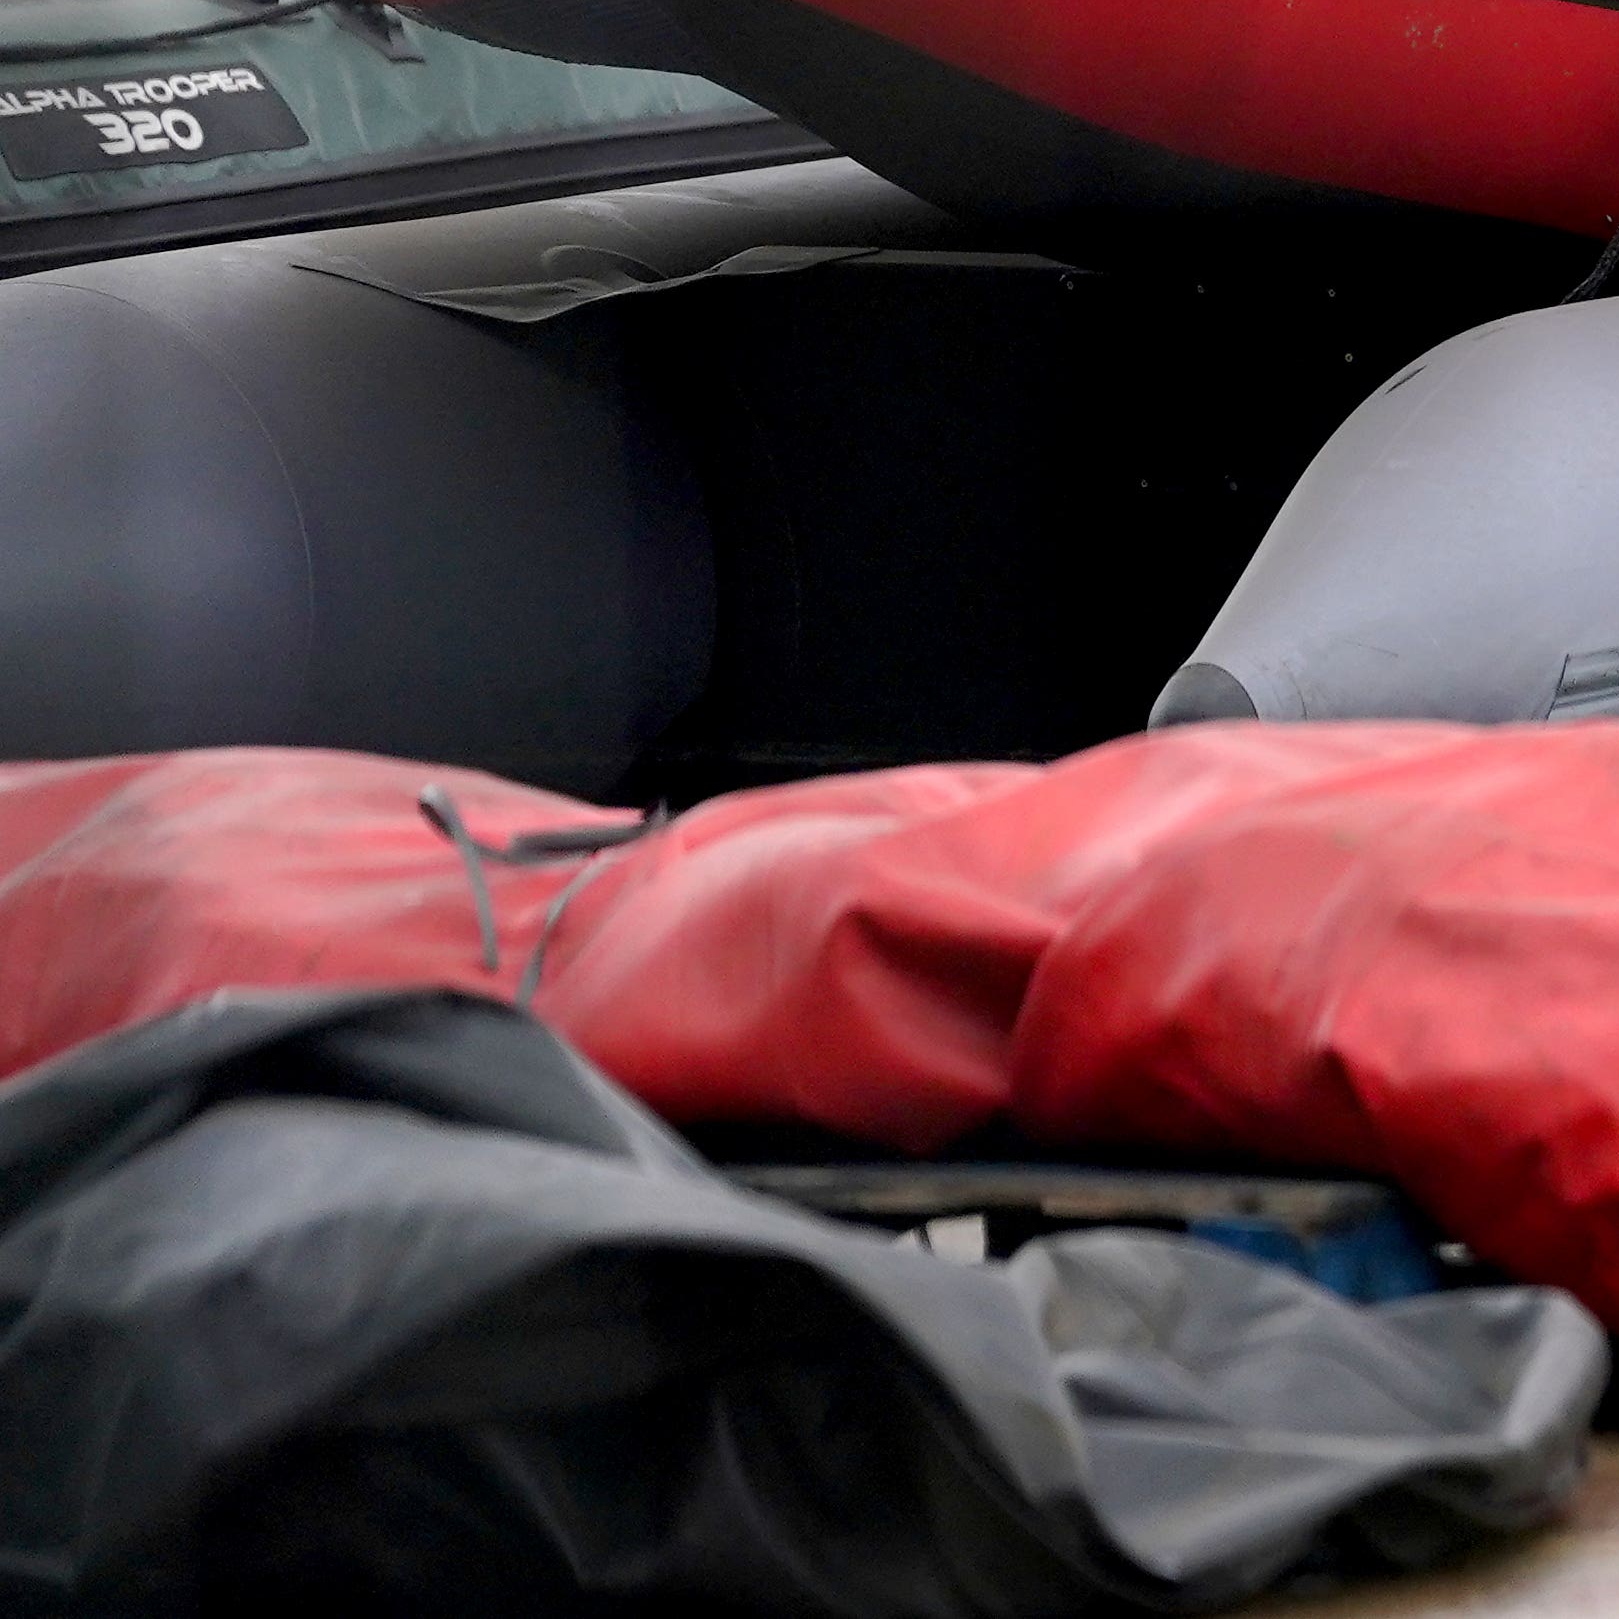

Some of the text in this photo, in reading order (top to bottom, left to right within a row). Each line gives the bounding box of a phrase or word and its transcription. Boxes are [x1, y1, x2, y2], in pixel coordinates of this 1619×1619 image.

[0, 68, 265, 116] ALPHA TROOPER
[83, 108, 205, 156] 320
